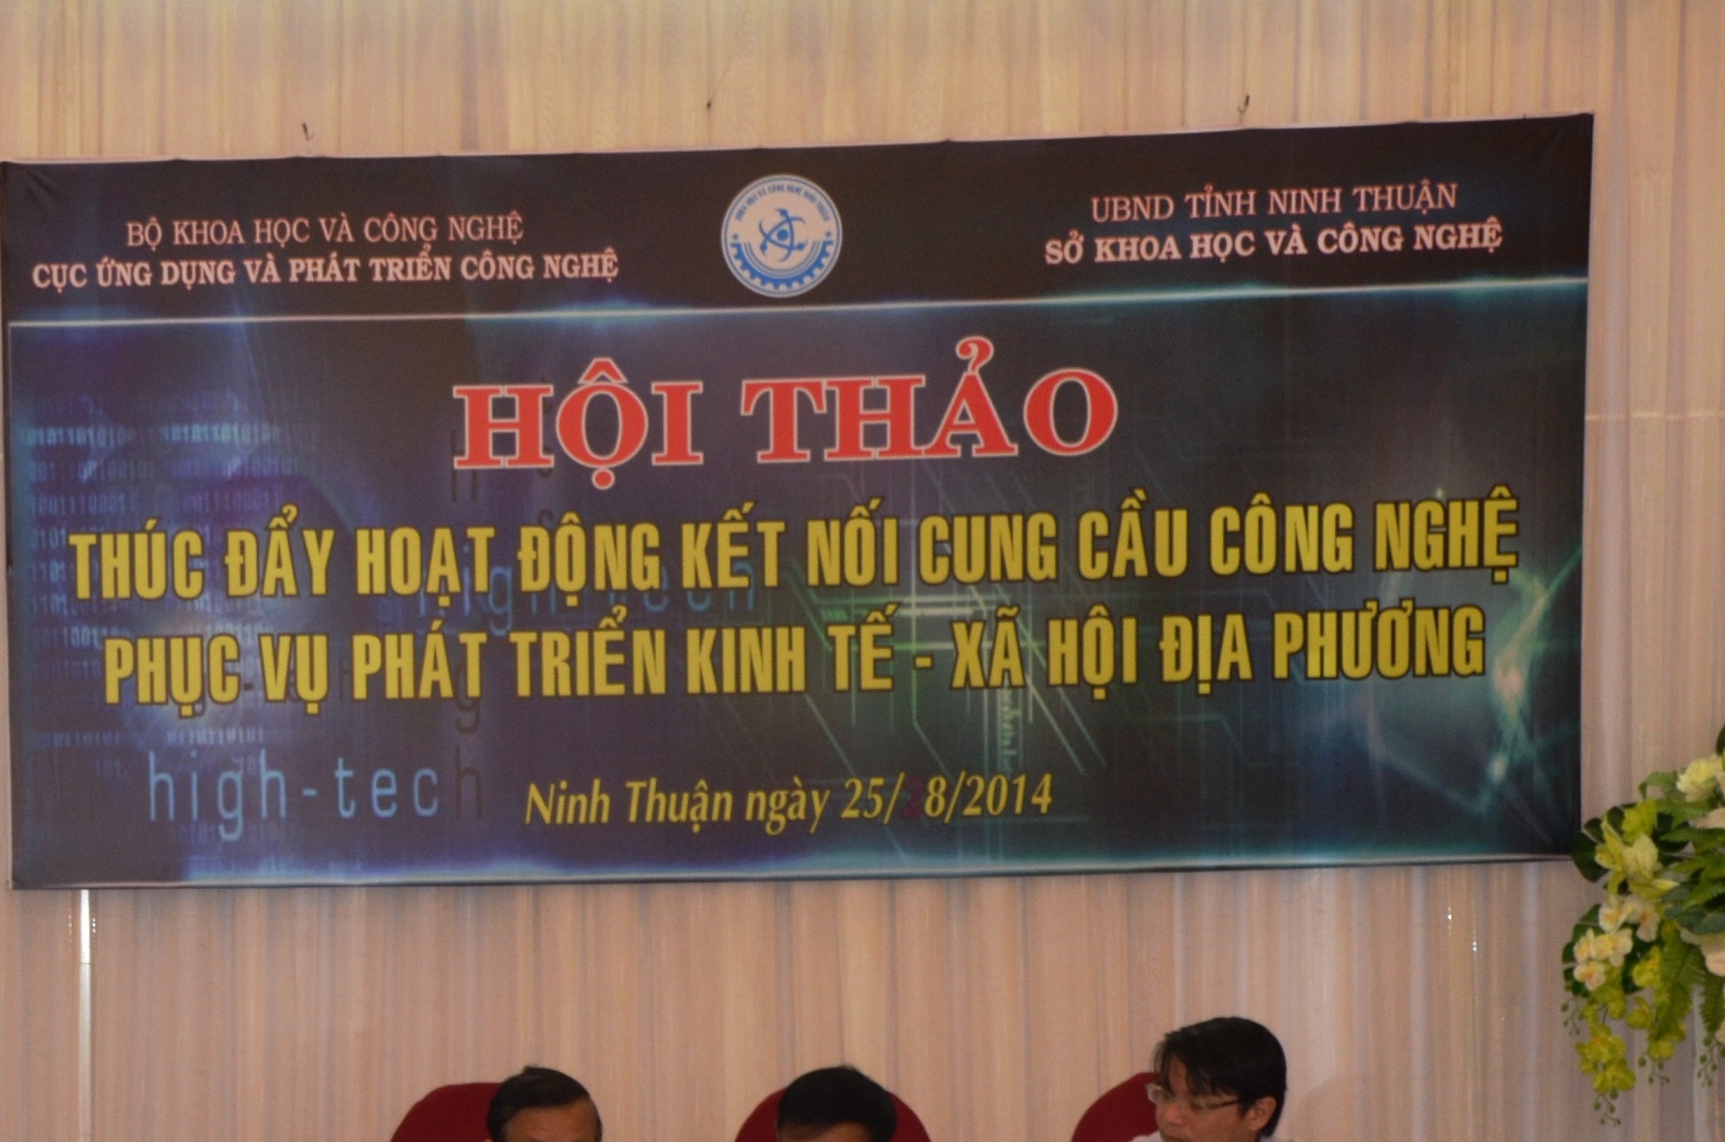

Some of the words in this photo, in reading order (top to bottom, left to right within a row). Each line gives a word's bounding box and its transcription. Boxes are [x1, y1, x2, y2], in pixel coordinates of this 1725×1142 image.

[1091, 193, 1175, 224] UBND
[1184, 184, 1256, 219] TỈNH
[1267, 188, 1342, 216] NINH
[1352, 178, 1458, 215] THUẬN
[127, 216, 162, 252] BỘ
[173, 219, 245, 246] KHOA
[254, 217, 310, 248] HỌC
[319, 213, 354, 243] VÀ
[363, 212, 438, 243] CÔNG
[448, 210, 524, 246] NGHỆ
[1045, 233, 1085, 266] SỞ
[1094, 233, 1182, 262] KHOA
[1189, 231, 1256, 264] HỌC
[1265, 222, 1308, 256] VÀ
[1317, 221, 1403, 256] CÔNG
[1413, 217, 1503, 252] NGHỆ
[33, 262, 87, 294] CỤC
[96, 257, 152, 288] ỨNG
[161, 261, 236, 291] DỤNG
[243, 252, 282, 283] VÀ
[289, 253, 361, 283] PHÁT
[369, 243, 451, 282] TRIỂN
[460, 250, 535, 281] CÔNG
[543, 248, 619, 283] NGHỆ
[452, 356, 704, 491] HỘI
[740, 335, 1119, 464] THẢO
[68, 517, 205, 601] THÚC
[224, 502, 336, 598] ĐẨY
[355, 524, 497, 608] HOẠT
[517, 510, 662, 608] ĐỘNG
[681, 500, 787, 591] KẾT
[807, 496, 899, 588] NỐI
[918, 511, 1059, 586] CUNG
[1078, 487, 1189, 581] CẦU
[1209, 491, 1355, 575] CÔNG
[1374, 484, 1520, 585] NGHỆ
[104, 632, 242, 720] PHỤC
[257, 632, 331, 716] VỤ
[352, 618, 488, 700] PHÁT
[509, 605, 668, 699] TRIỂN
[685, 625, 807, 697] KINH
[826, 602, 902, 693] TẾ
[914, 654, 934, 670] -
[950, 603, 1028, 691] XÃ
[1046, 604, 1138, 701] HỘI
[1159, 611, 1255, 696] ĐỊA
[1274, 598, 1487, 682] PHƯƠNG
[524, 778, 611, 826] Ninh
[625, 779, 733, 834] Thuận
[745, 774, 830, 836] ngày
